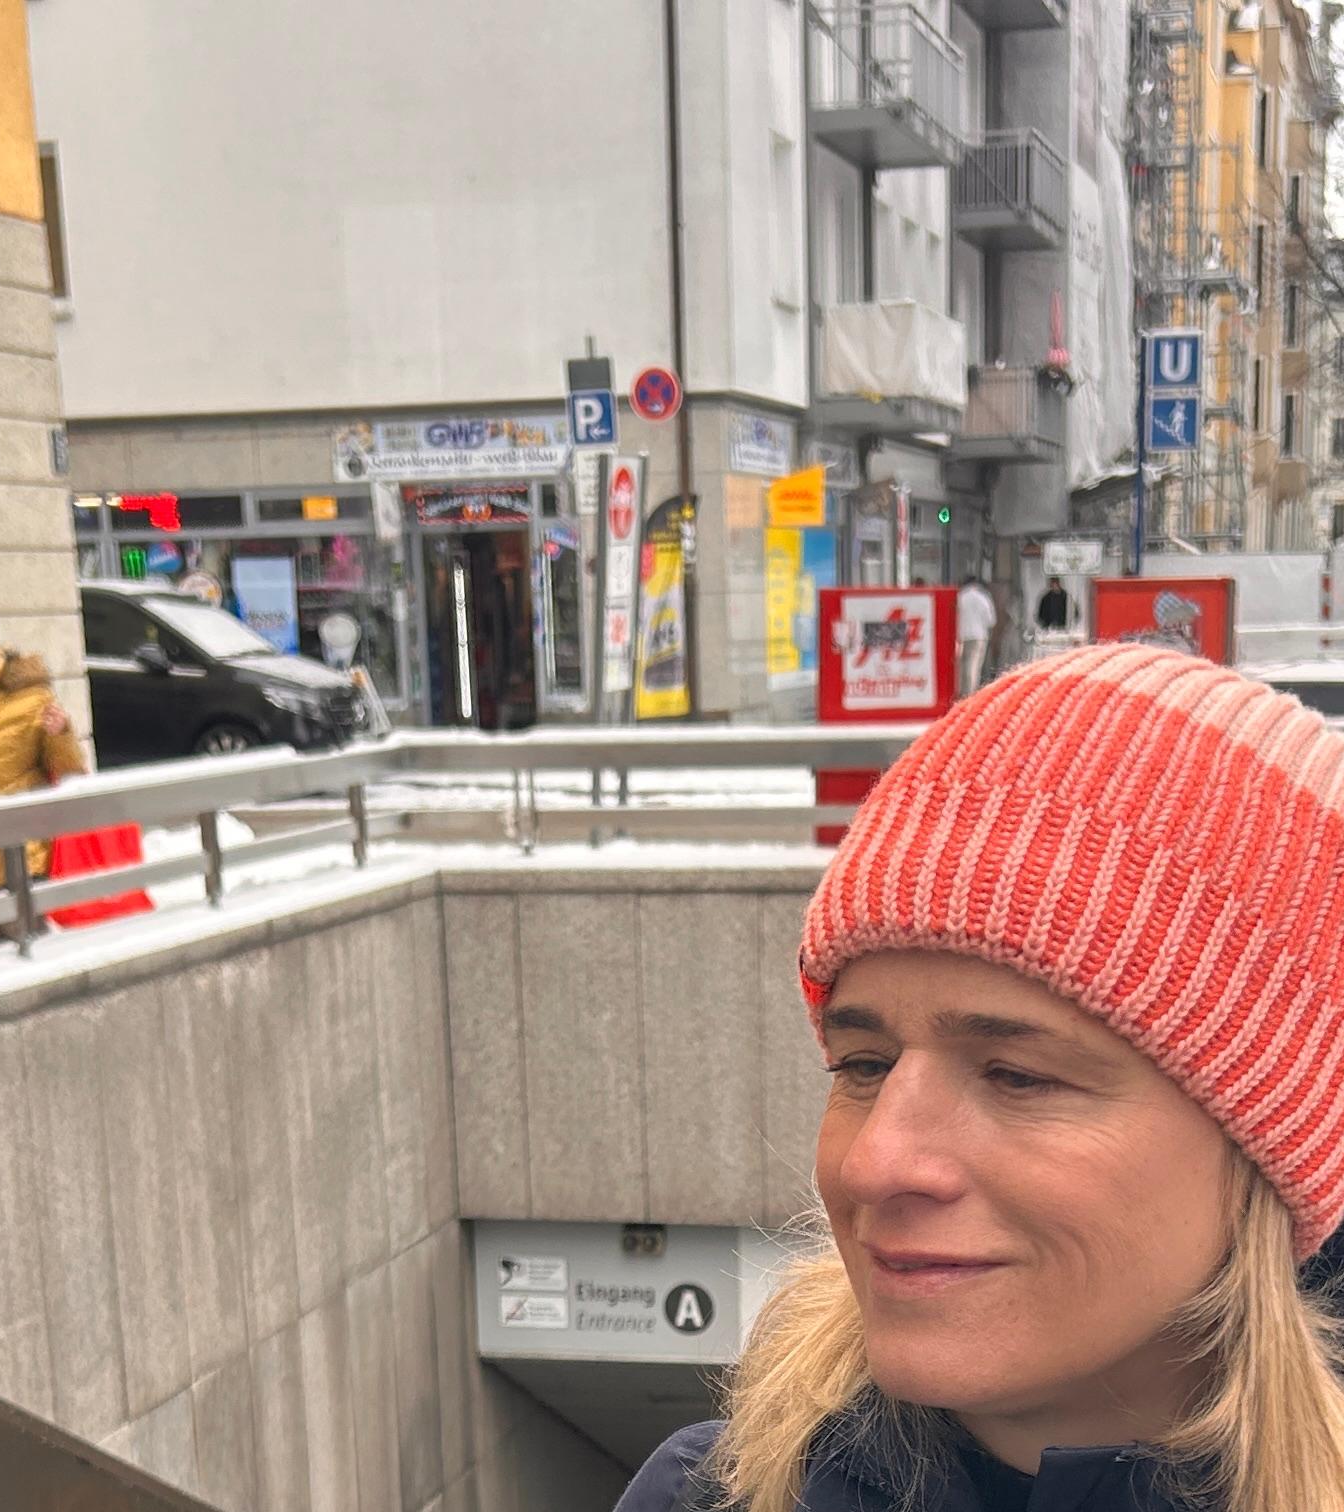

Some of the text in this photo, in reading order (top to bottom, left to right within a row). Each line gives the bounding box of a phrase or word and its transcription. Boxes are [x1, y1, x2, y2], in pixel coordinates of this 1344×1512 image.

[1159, 340, 1192, 382] U
[574, 398, 603, 440] P
[576, 1281, 655, 1309] Eingang
[675, 1289, 704, 1328] A
[576, 1310, 655, 1333] Entrance
